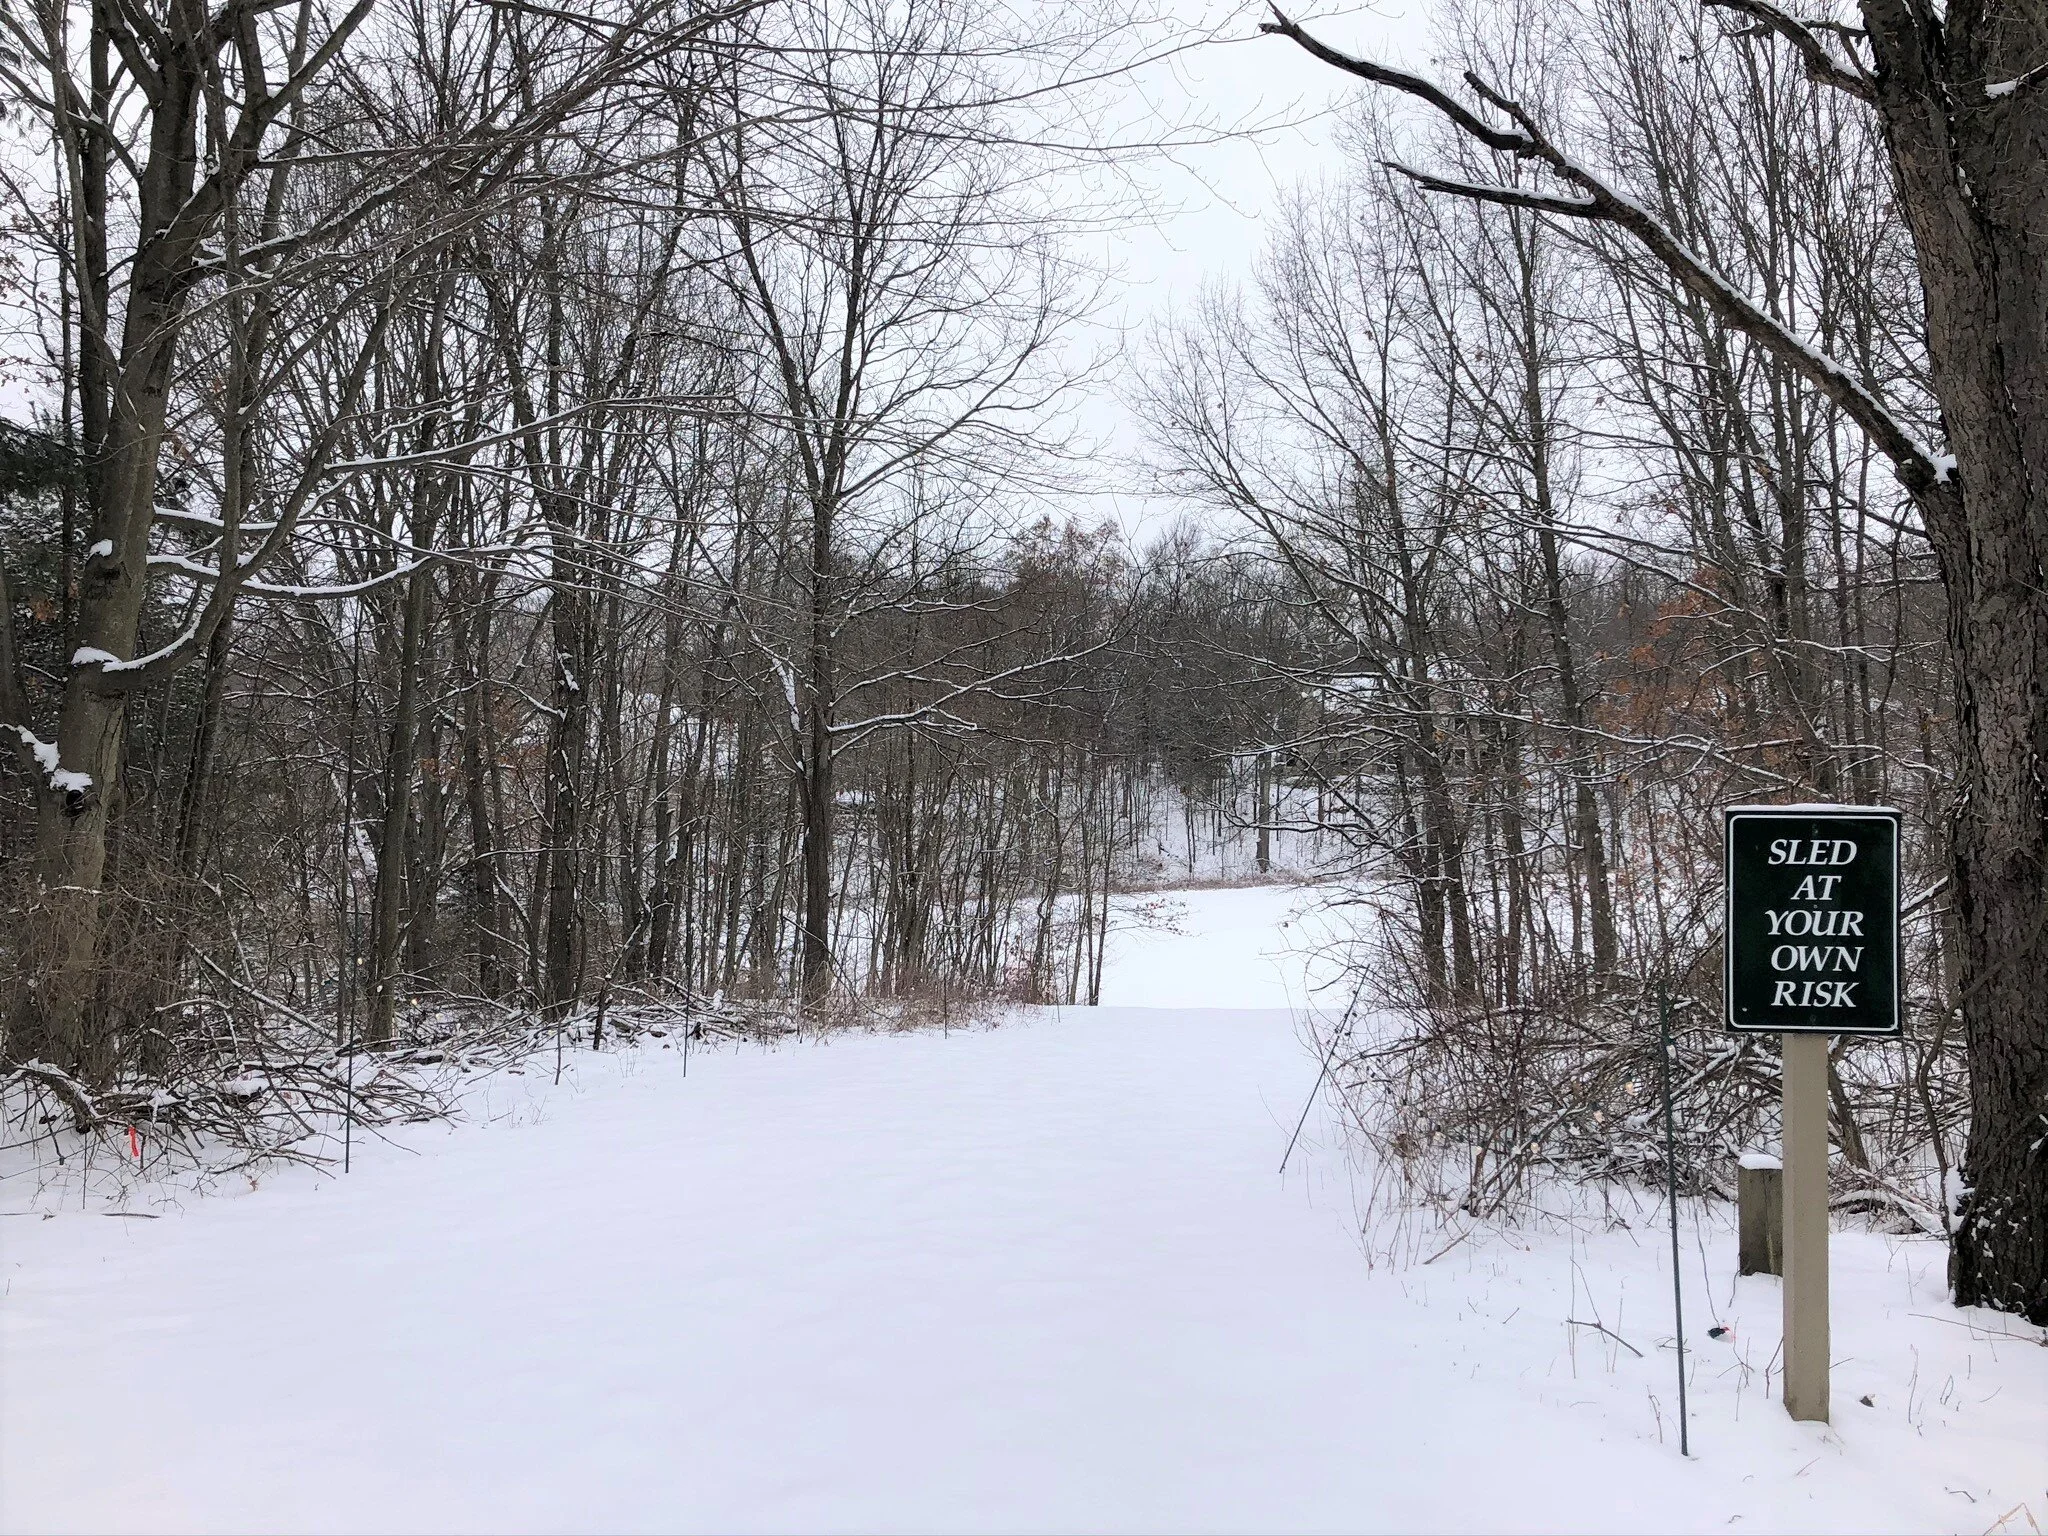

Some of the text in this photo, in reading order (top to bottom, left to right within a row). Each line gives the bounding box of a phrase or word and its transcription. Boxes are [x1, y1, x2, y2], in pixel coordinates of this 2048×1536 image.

[1768, 839, 1857, 865] SLED
[1791, 875, 1841, 901] AT
[1765, 910, 1864, 936] YOUR
[1771, 945, 1864, 972] OWN
[1771, 981, 1859, 1007] RISK
